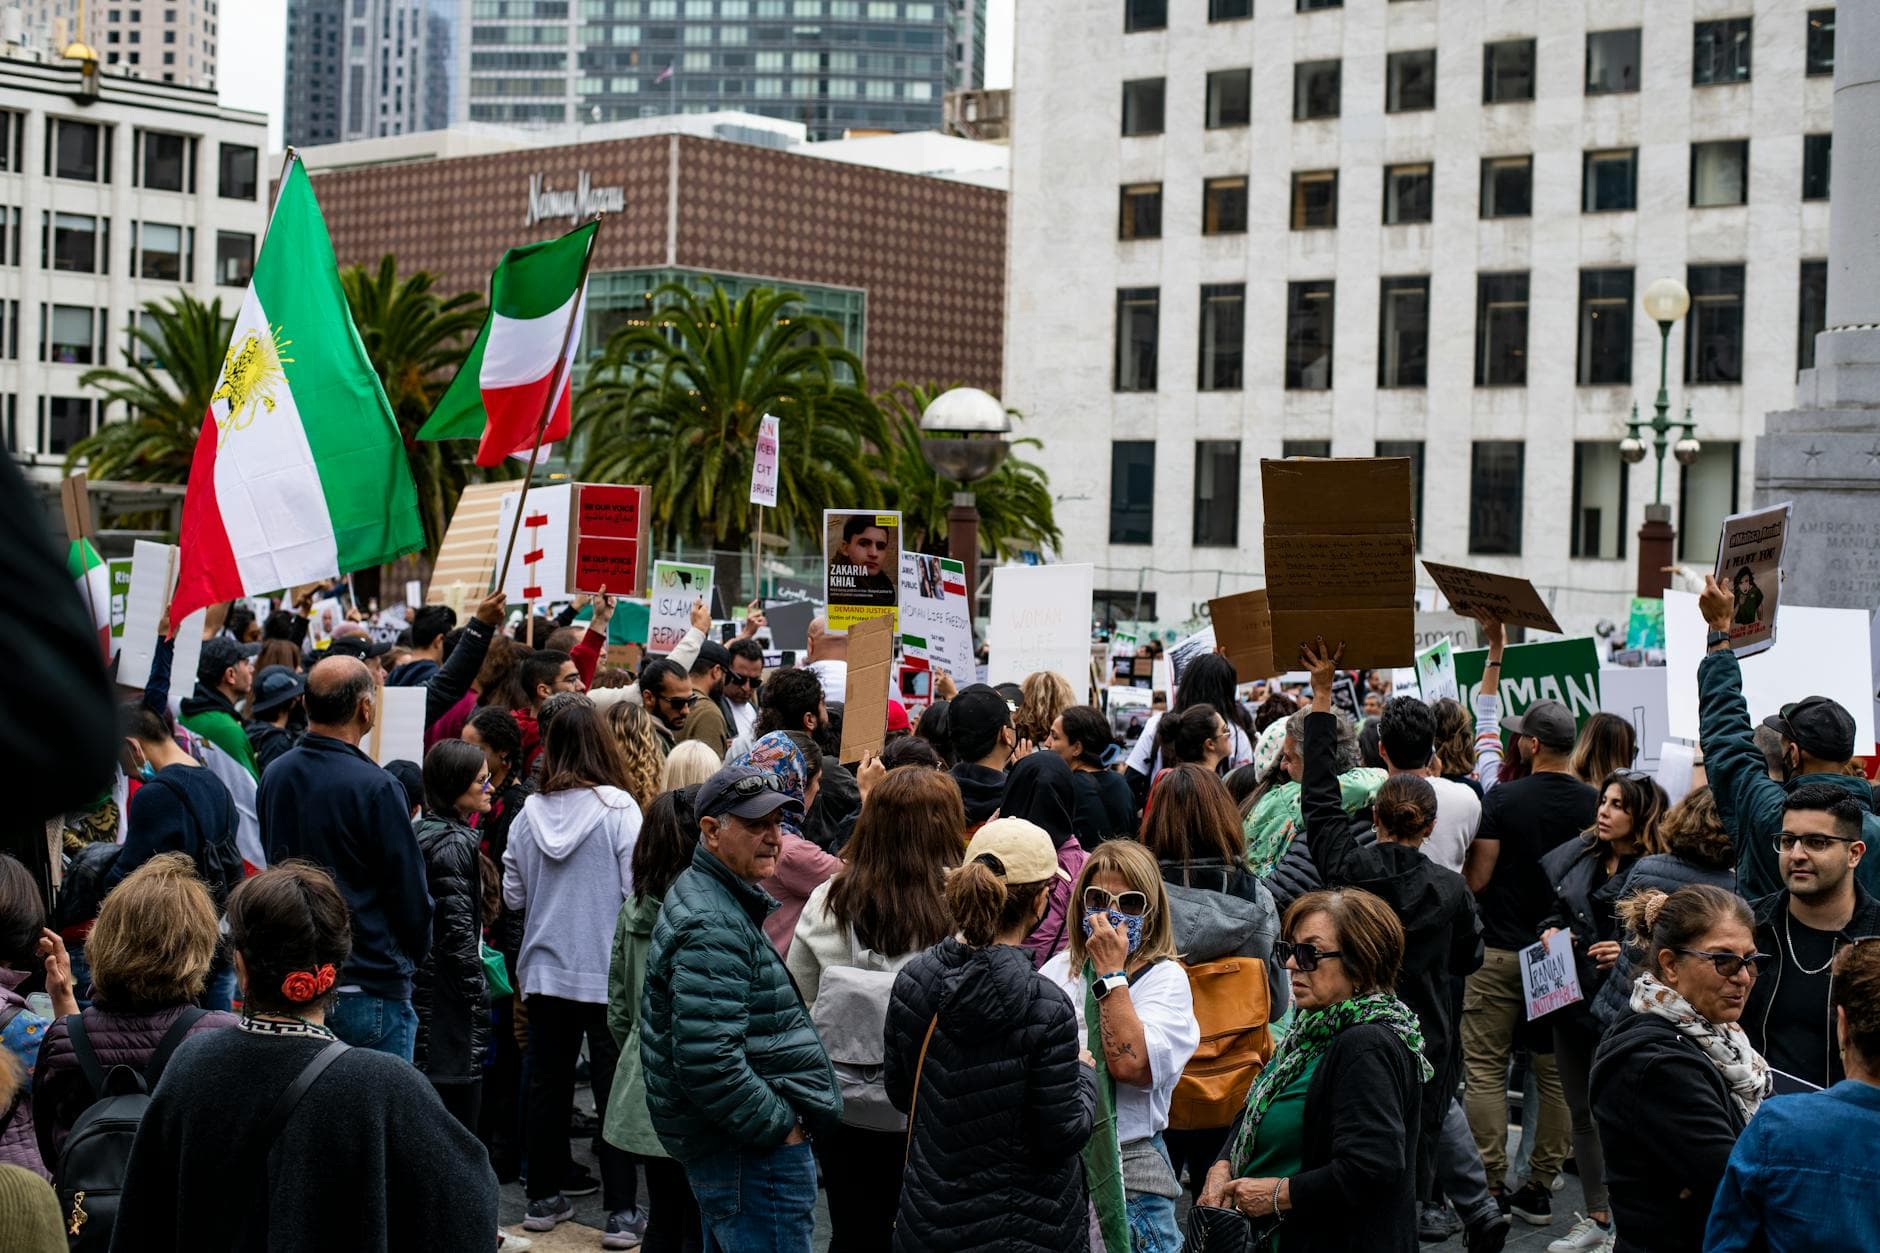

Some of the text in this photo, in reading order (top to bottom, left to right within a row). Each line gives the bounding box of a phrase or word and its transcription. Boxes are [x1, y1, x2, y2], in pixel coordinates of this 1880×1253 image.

[1799, 521, 1880, 536] AMERICAN S
[1826, 536, 1880, 550] MANILA
[830, 564, 868, 577] ZAKARIA
[661, 570, 679, 588] NO
[830, 576, 857, 588] KHIAL
[1829, 579, 1880, 592] BALTIM
[659, 597, 692, 617] ISLAM
[834, 605, 892, 615] DEMAND JUSTICE
[653, 626, 687, 645] REPUB
[1415, 629, 1468, 646] omen
[1526, 950, 1566, 989] IRANIAN
[1530, 983, 1550, 998] WOMEN
[1528, 980, 1583, 1018] UNSTOPPABLE
